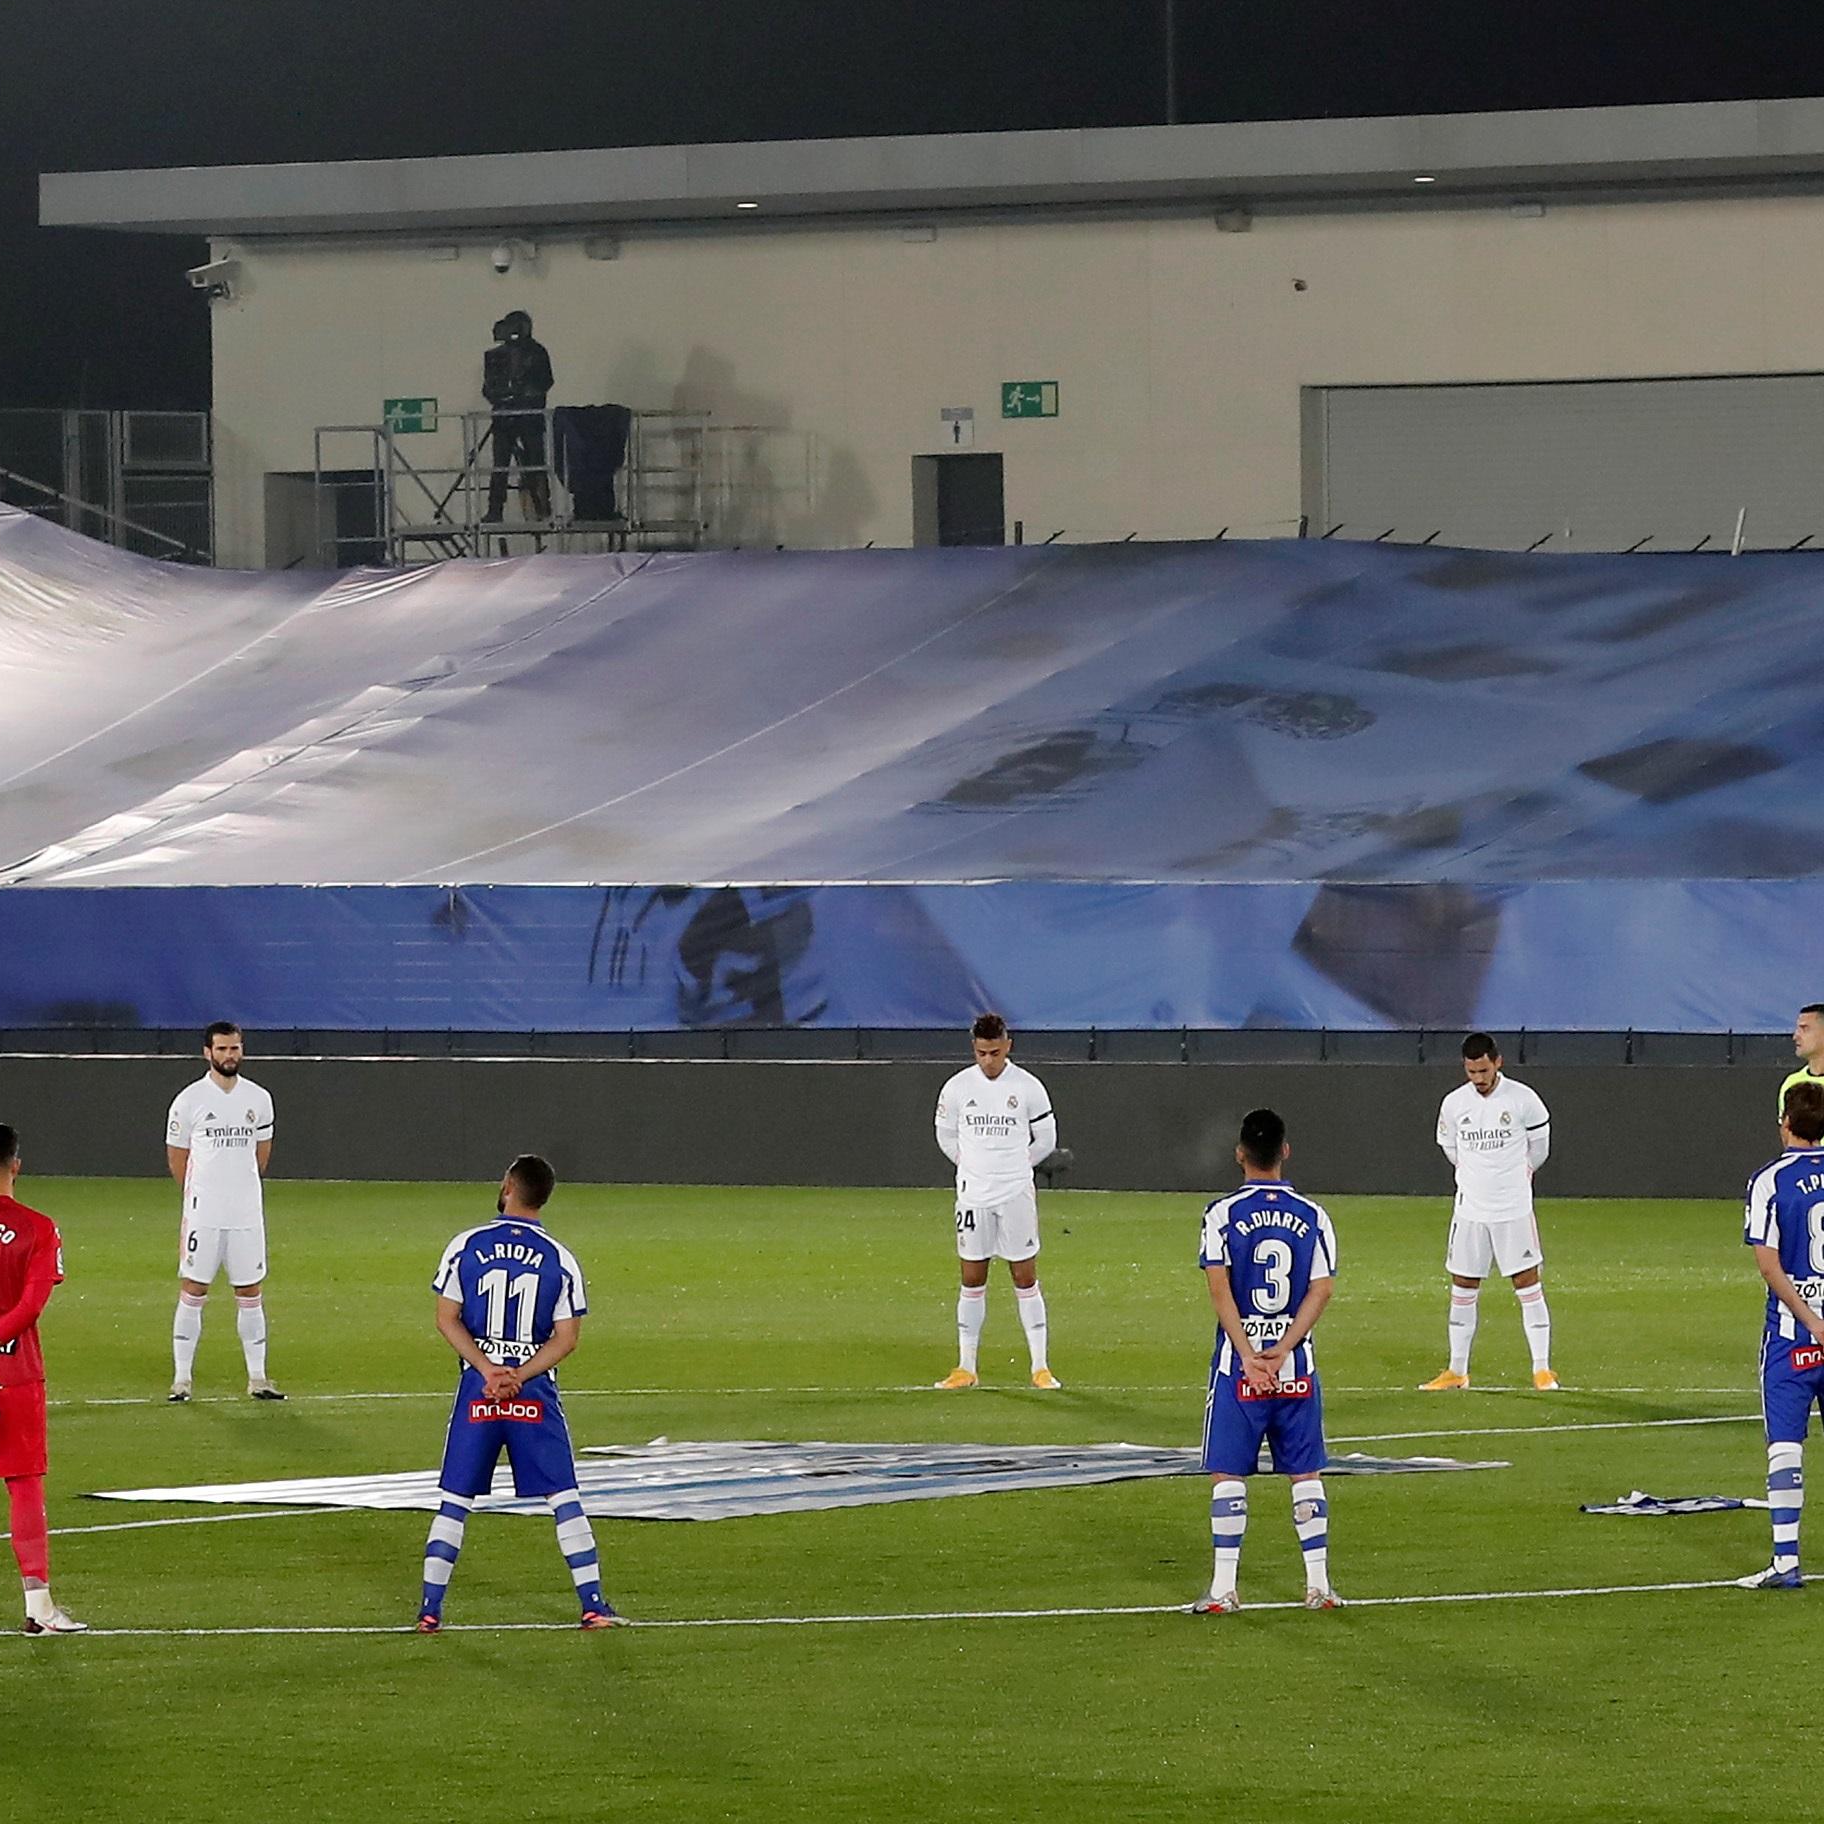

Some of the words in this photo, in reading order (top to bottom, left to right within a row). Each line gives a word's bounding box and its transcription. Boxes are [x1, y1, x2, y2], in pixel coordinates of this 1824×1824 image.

[956, 1209, 976, 1233] 24
[1235, 1210, 1310, 1239] R.DUARTE
[187, 1229, 198, 1253] 6
[475, 1242, 545, 1269] L.RIOJA
[1251, 1238, 1293, 1315] 3
[477, 1268, 540, 1344] 11
